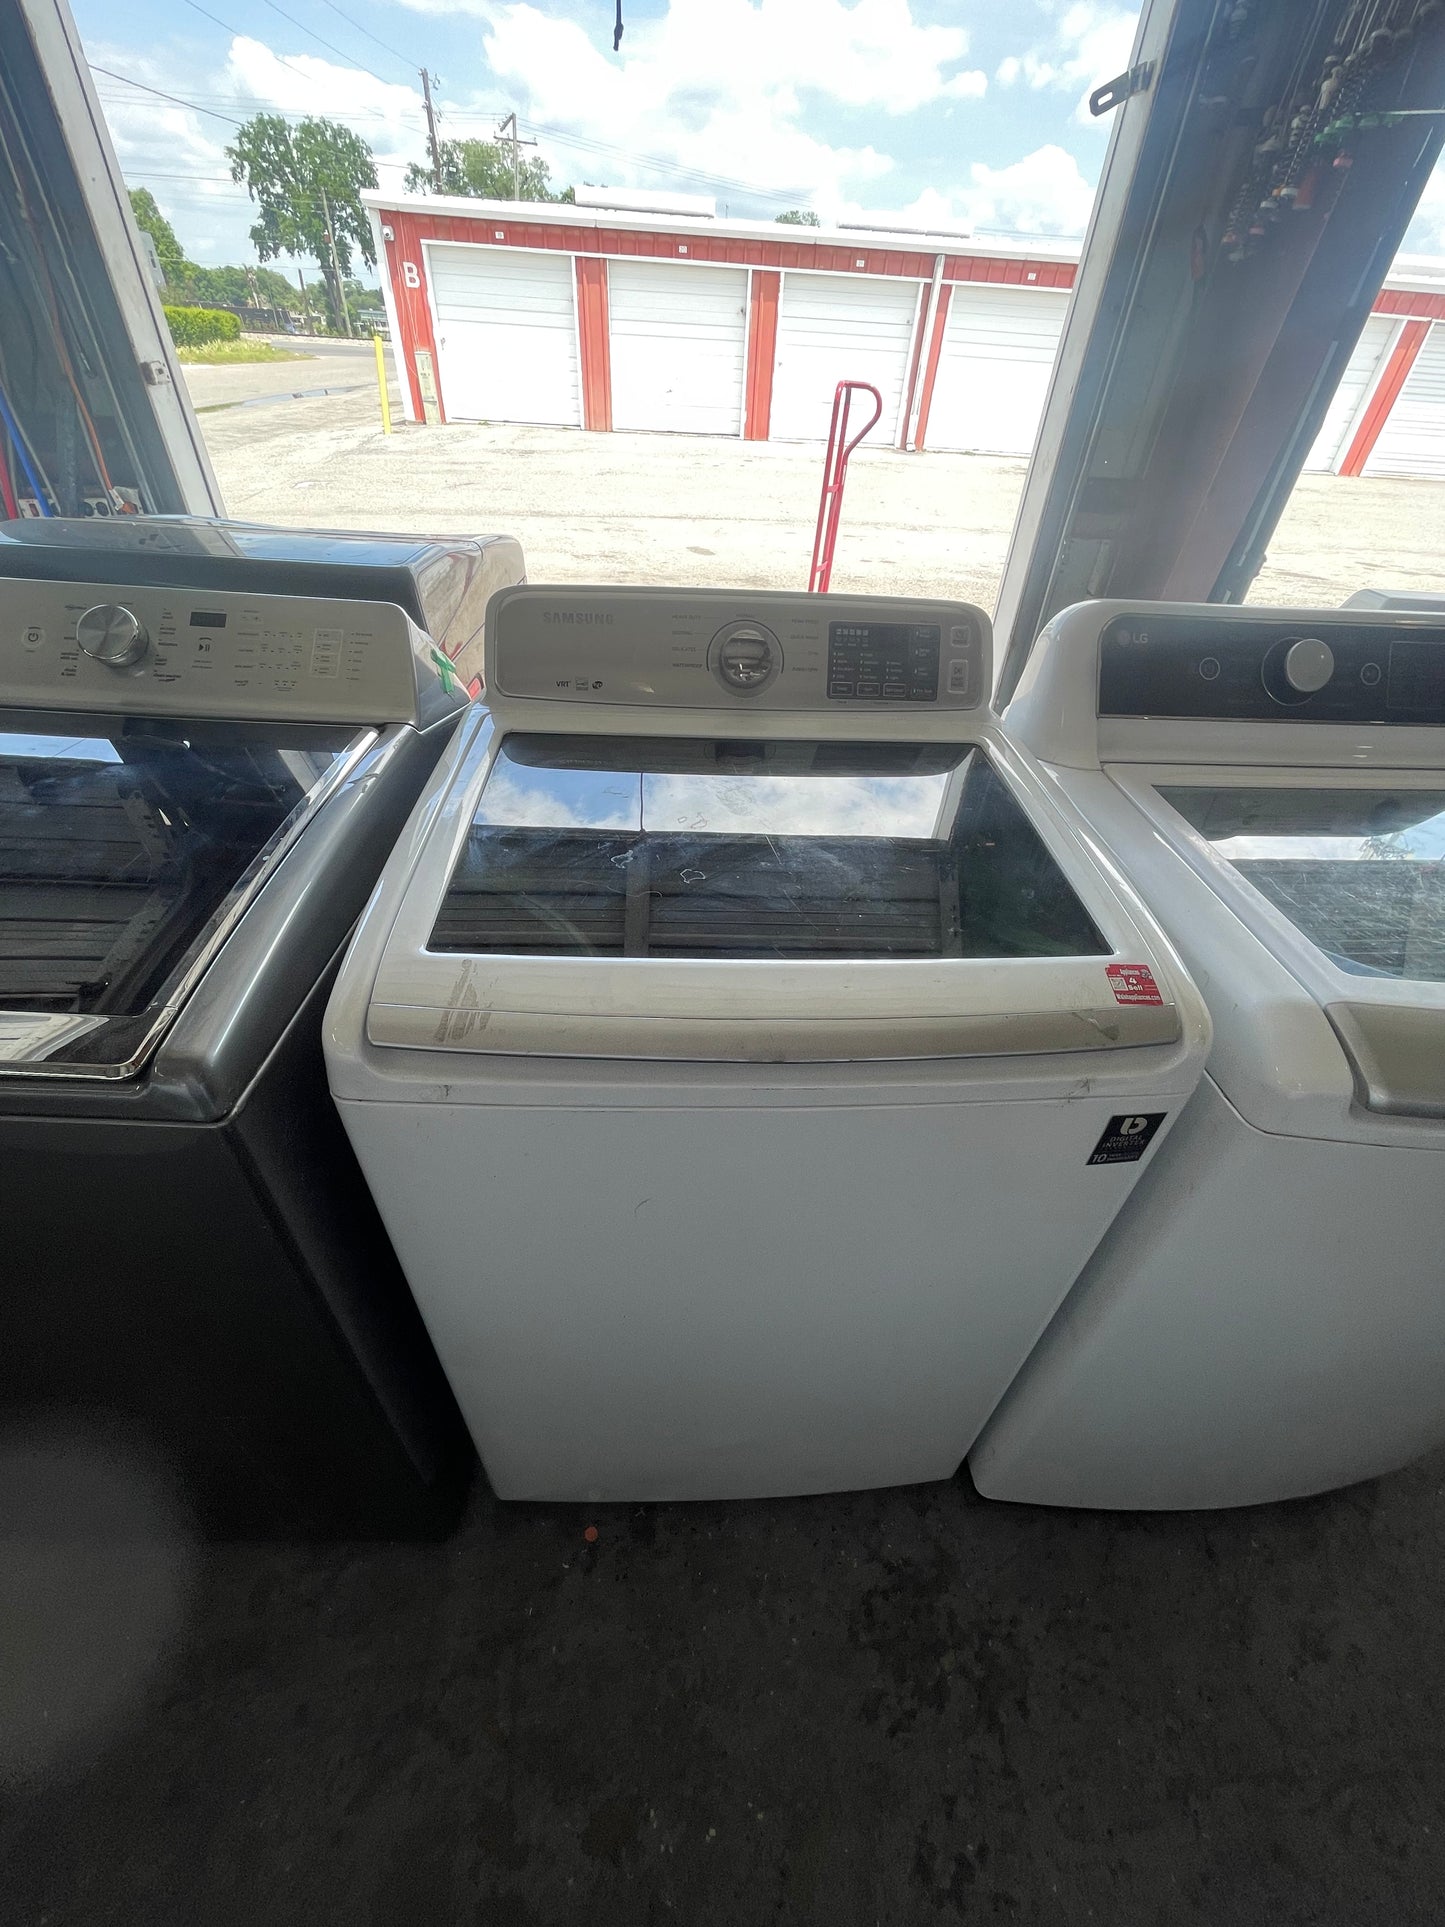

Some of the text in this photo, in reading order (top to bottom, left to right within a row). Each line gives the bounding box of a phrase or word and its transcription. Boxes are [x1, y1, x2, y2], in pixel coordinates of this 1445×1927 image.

[403, 261, 421, 289] B
[543, 611, 614, 625] SAMSUNG
[1132, 633, 1149, 644] LG
[556, 680, 570, 688] VRT
[1129, 977, 1138, 985] 4
[1102, 1140, 1145, 1149] INVERTER
[1091, 1153, 1108, 1164] 10
